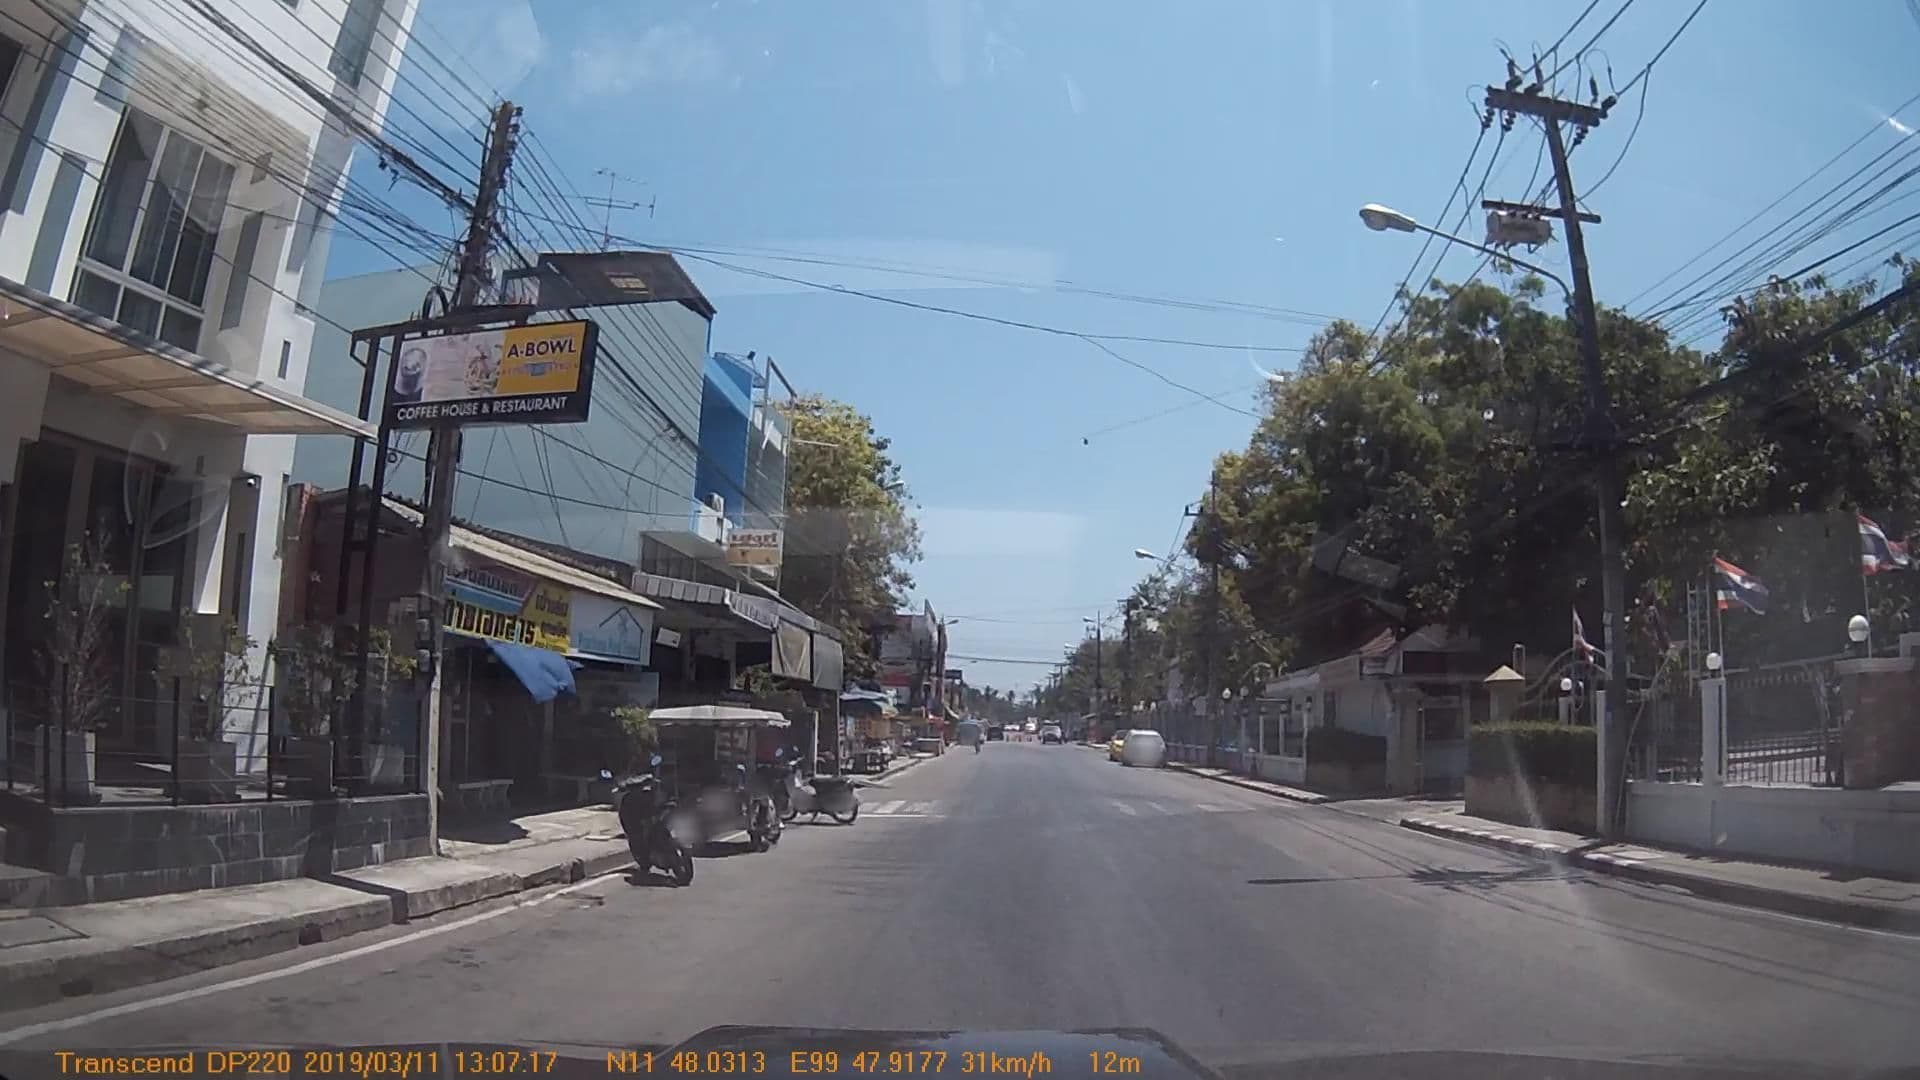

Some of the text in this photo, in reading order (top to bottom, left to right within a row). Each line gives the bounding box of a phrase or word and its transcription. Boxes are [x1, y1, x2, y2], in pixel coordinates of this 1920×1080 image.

[506, 337, 577, 358] A-BOWL
[396, 396, 569, 420] COFFEE HOUSE & RESTAURANT
